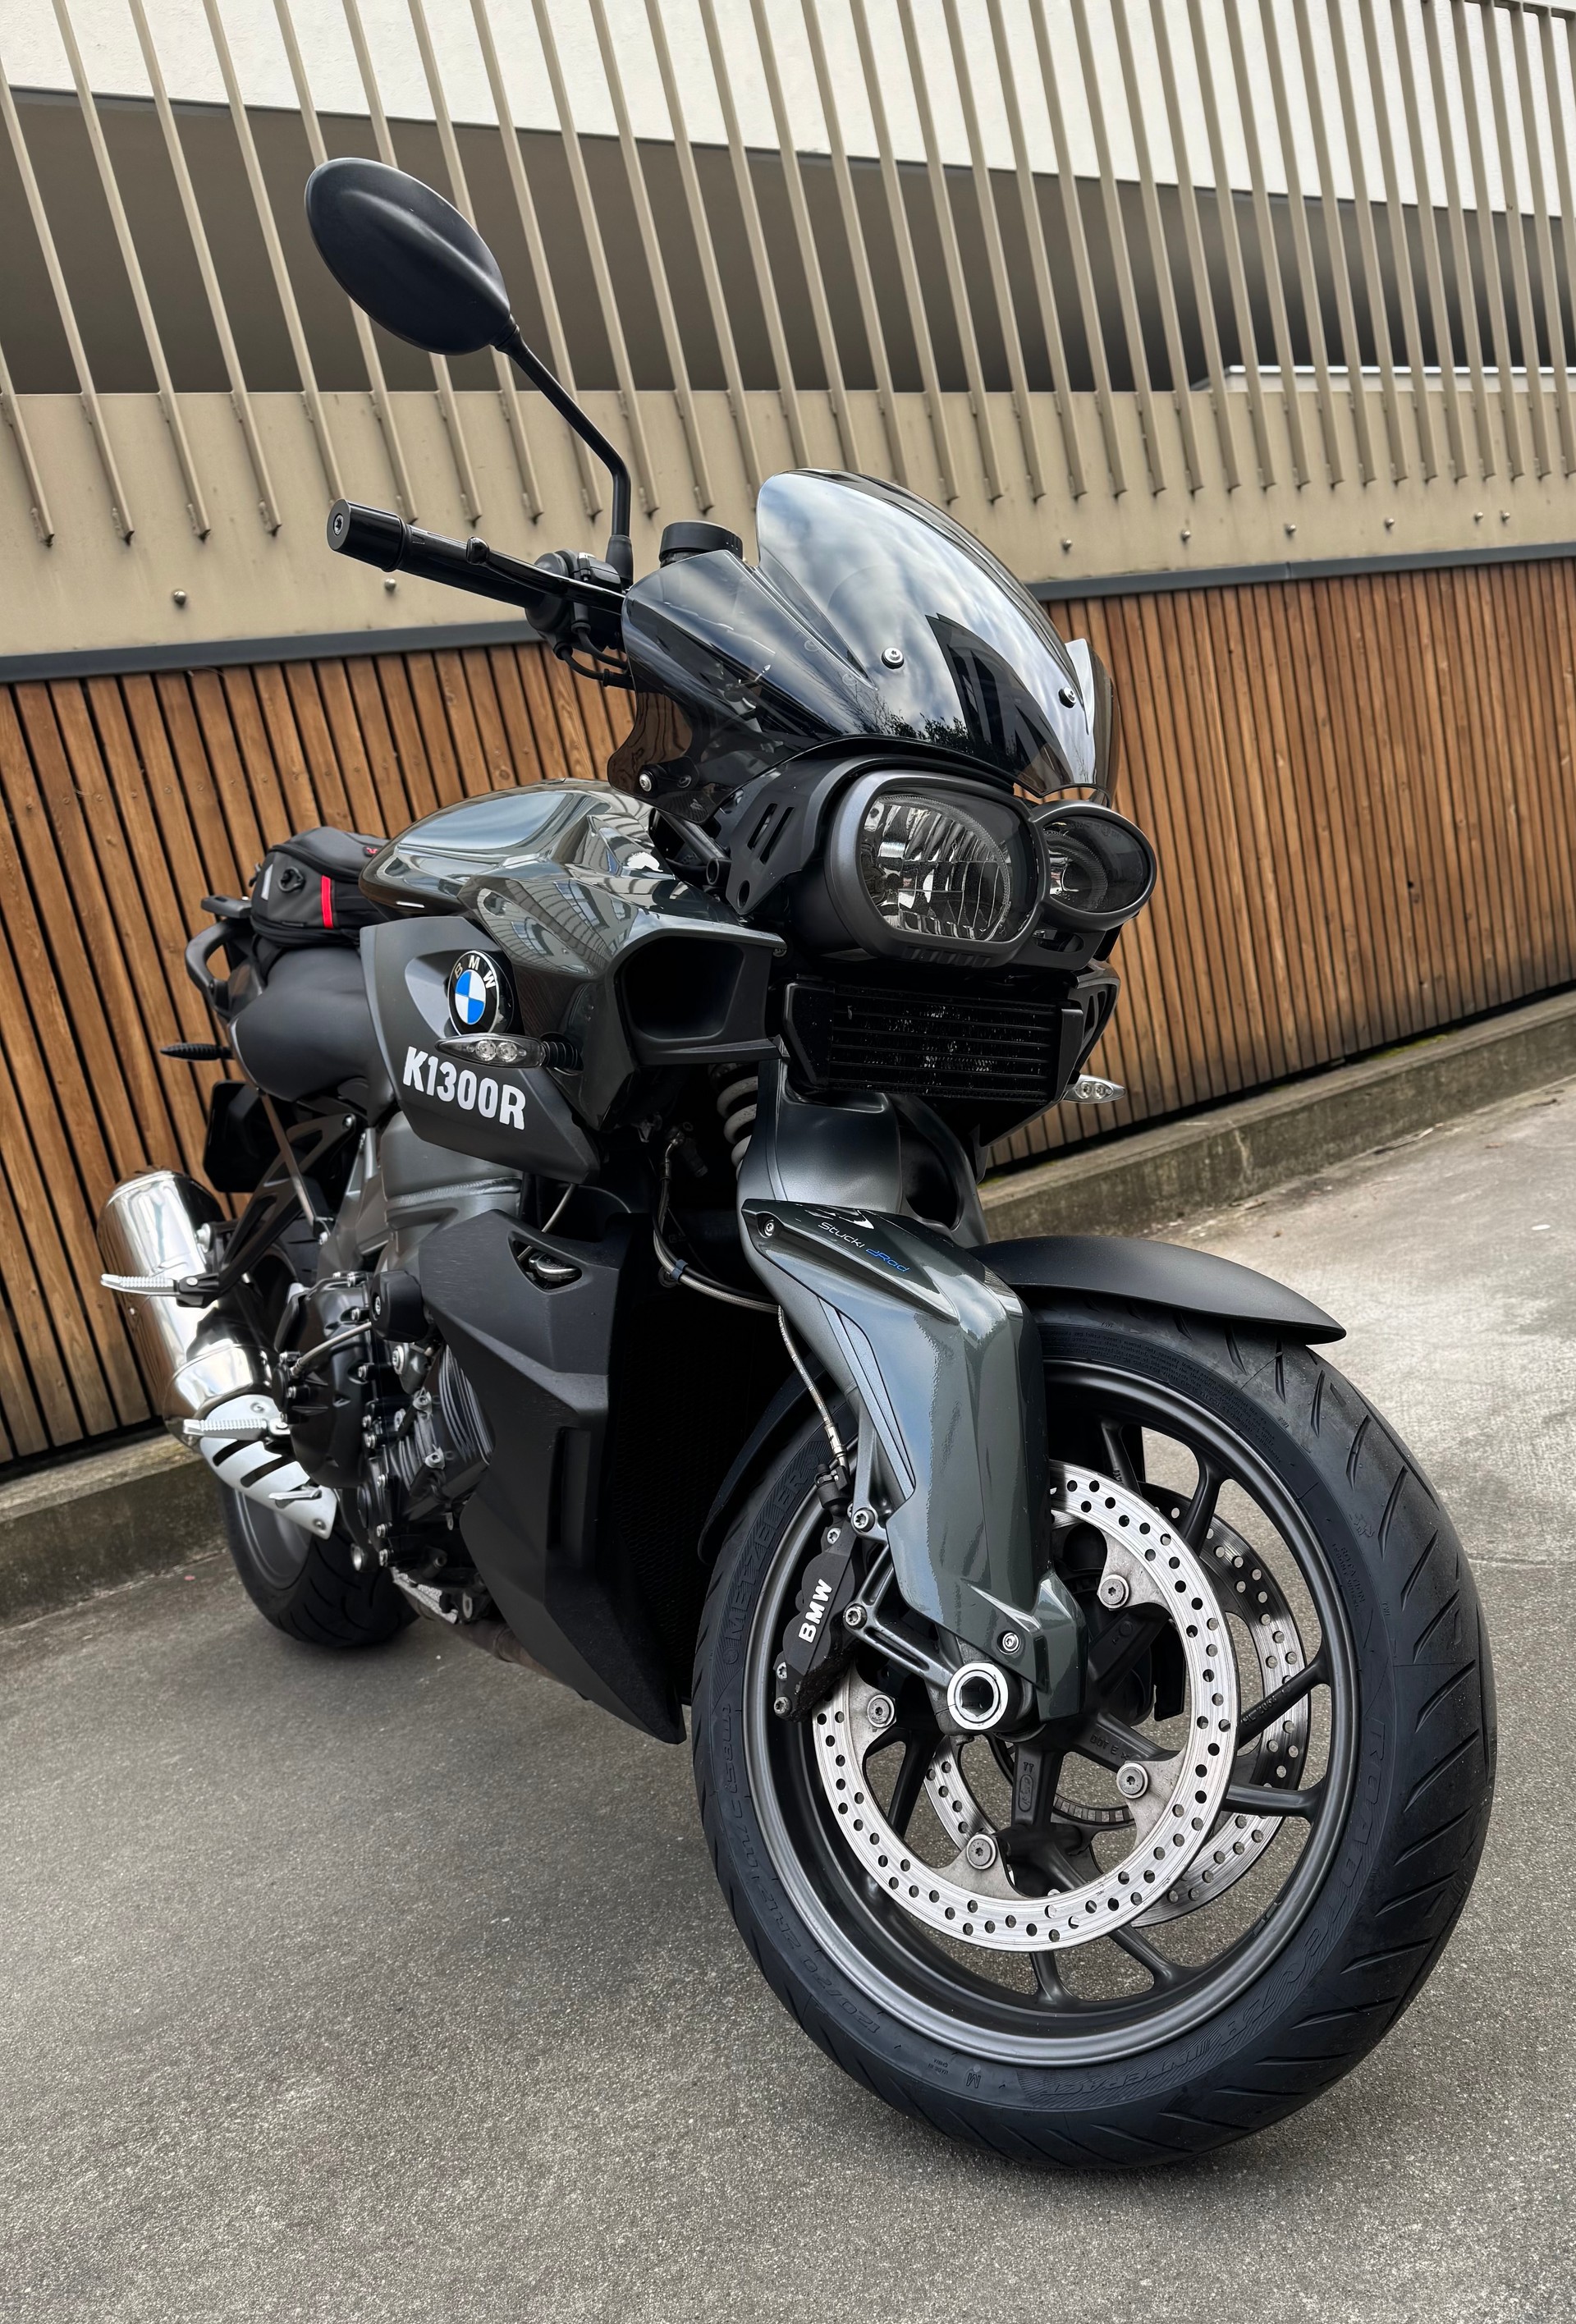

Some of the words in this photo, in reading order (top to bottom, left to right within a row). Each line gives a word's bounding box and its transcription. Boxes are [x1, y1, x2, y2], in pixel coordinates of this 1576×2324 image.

[453, 955, 496, 989] BMW
[402, 1046, 526, 1130] K1300R
[818, 1222, 865, 1248] Stucki
[726, 1469, 809, 1641] METZELER
[798, 1579, 832, 1643] BMW
[966, 2072, 982, 2089] M
